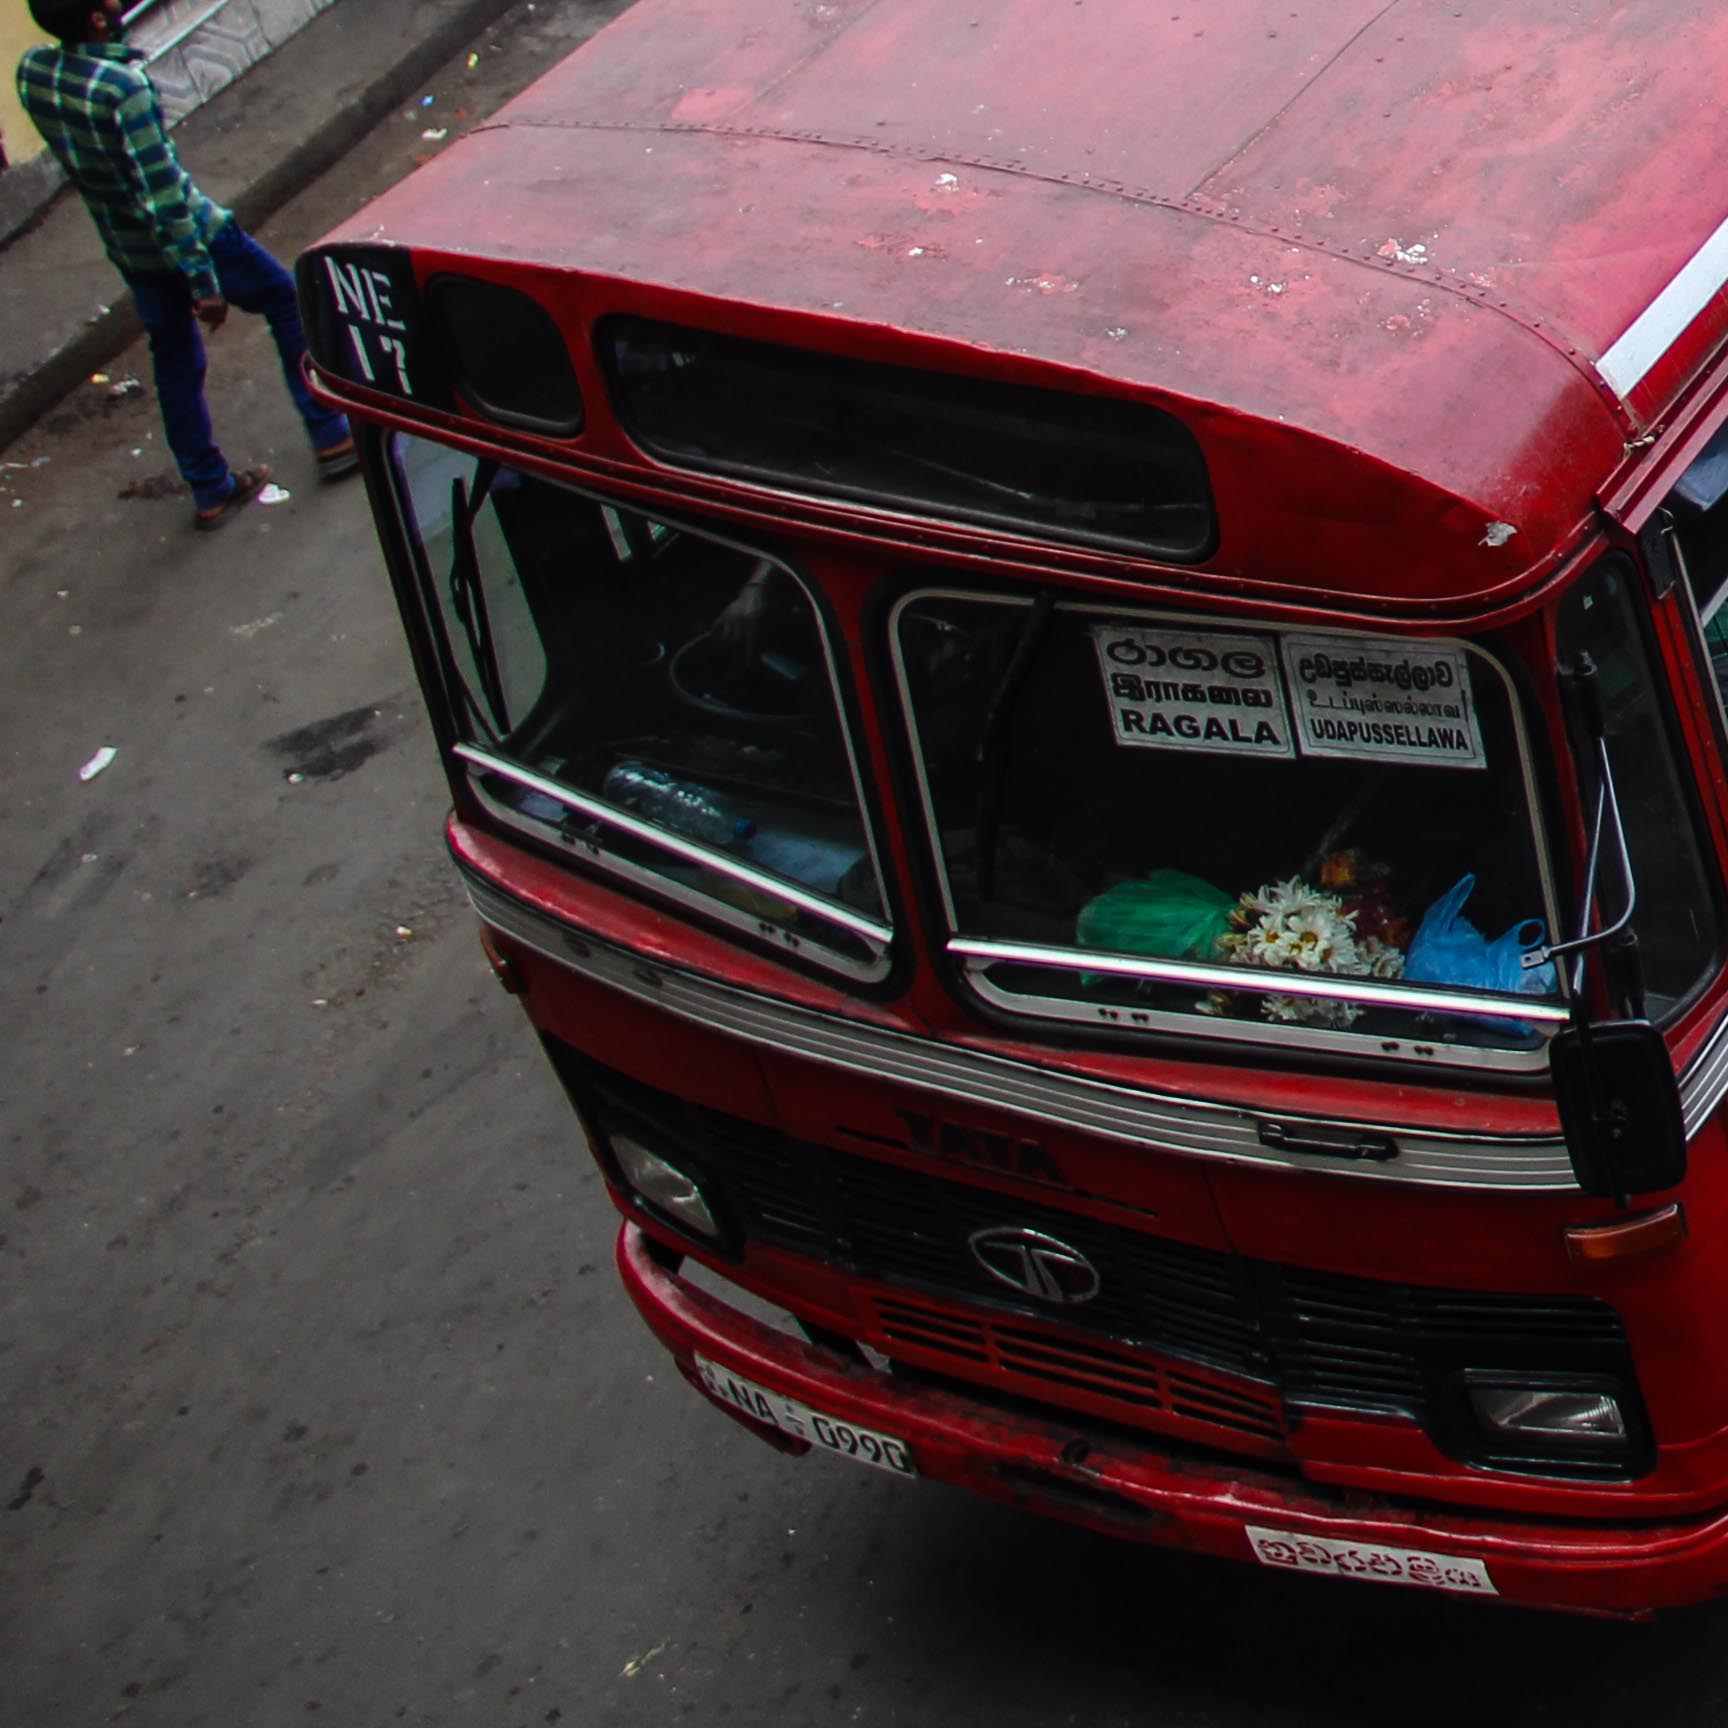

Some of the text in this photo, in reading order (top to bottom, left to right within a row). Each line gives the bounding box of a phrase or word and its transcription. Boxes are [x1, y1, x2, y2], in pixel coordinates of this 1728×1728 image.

[324, 255, 407, 332] NE
[348, 324, 413, 396] 17
[1106, 637, 1268, 680] රාගල
[1120, 708, 1282, 747] RAGALA
[1309, 717, 1471, 753] UDAPUSSELLAWA
[726, 1377, 779, 1426] NA
